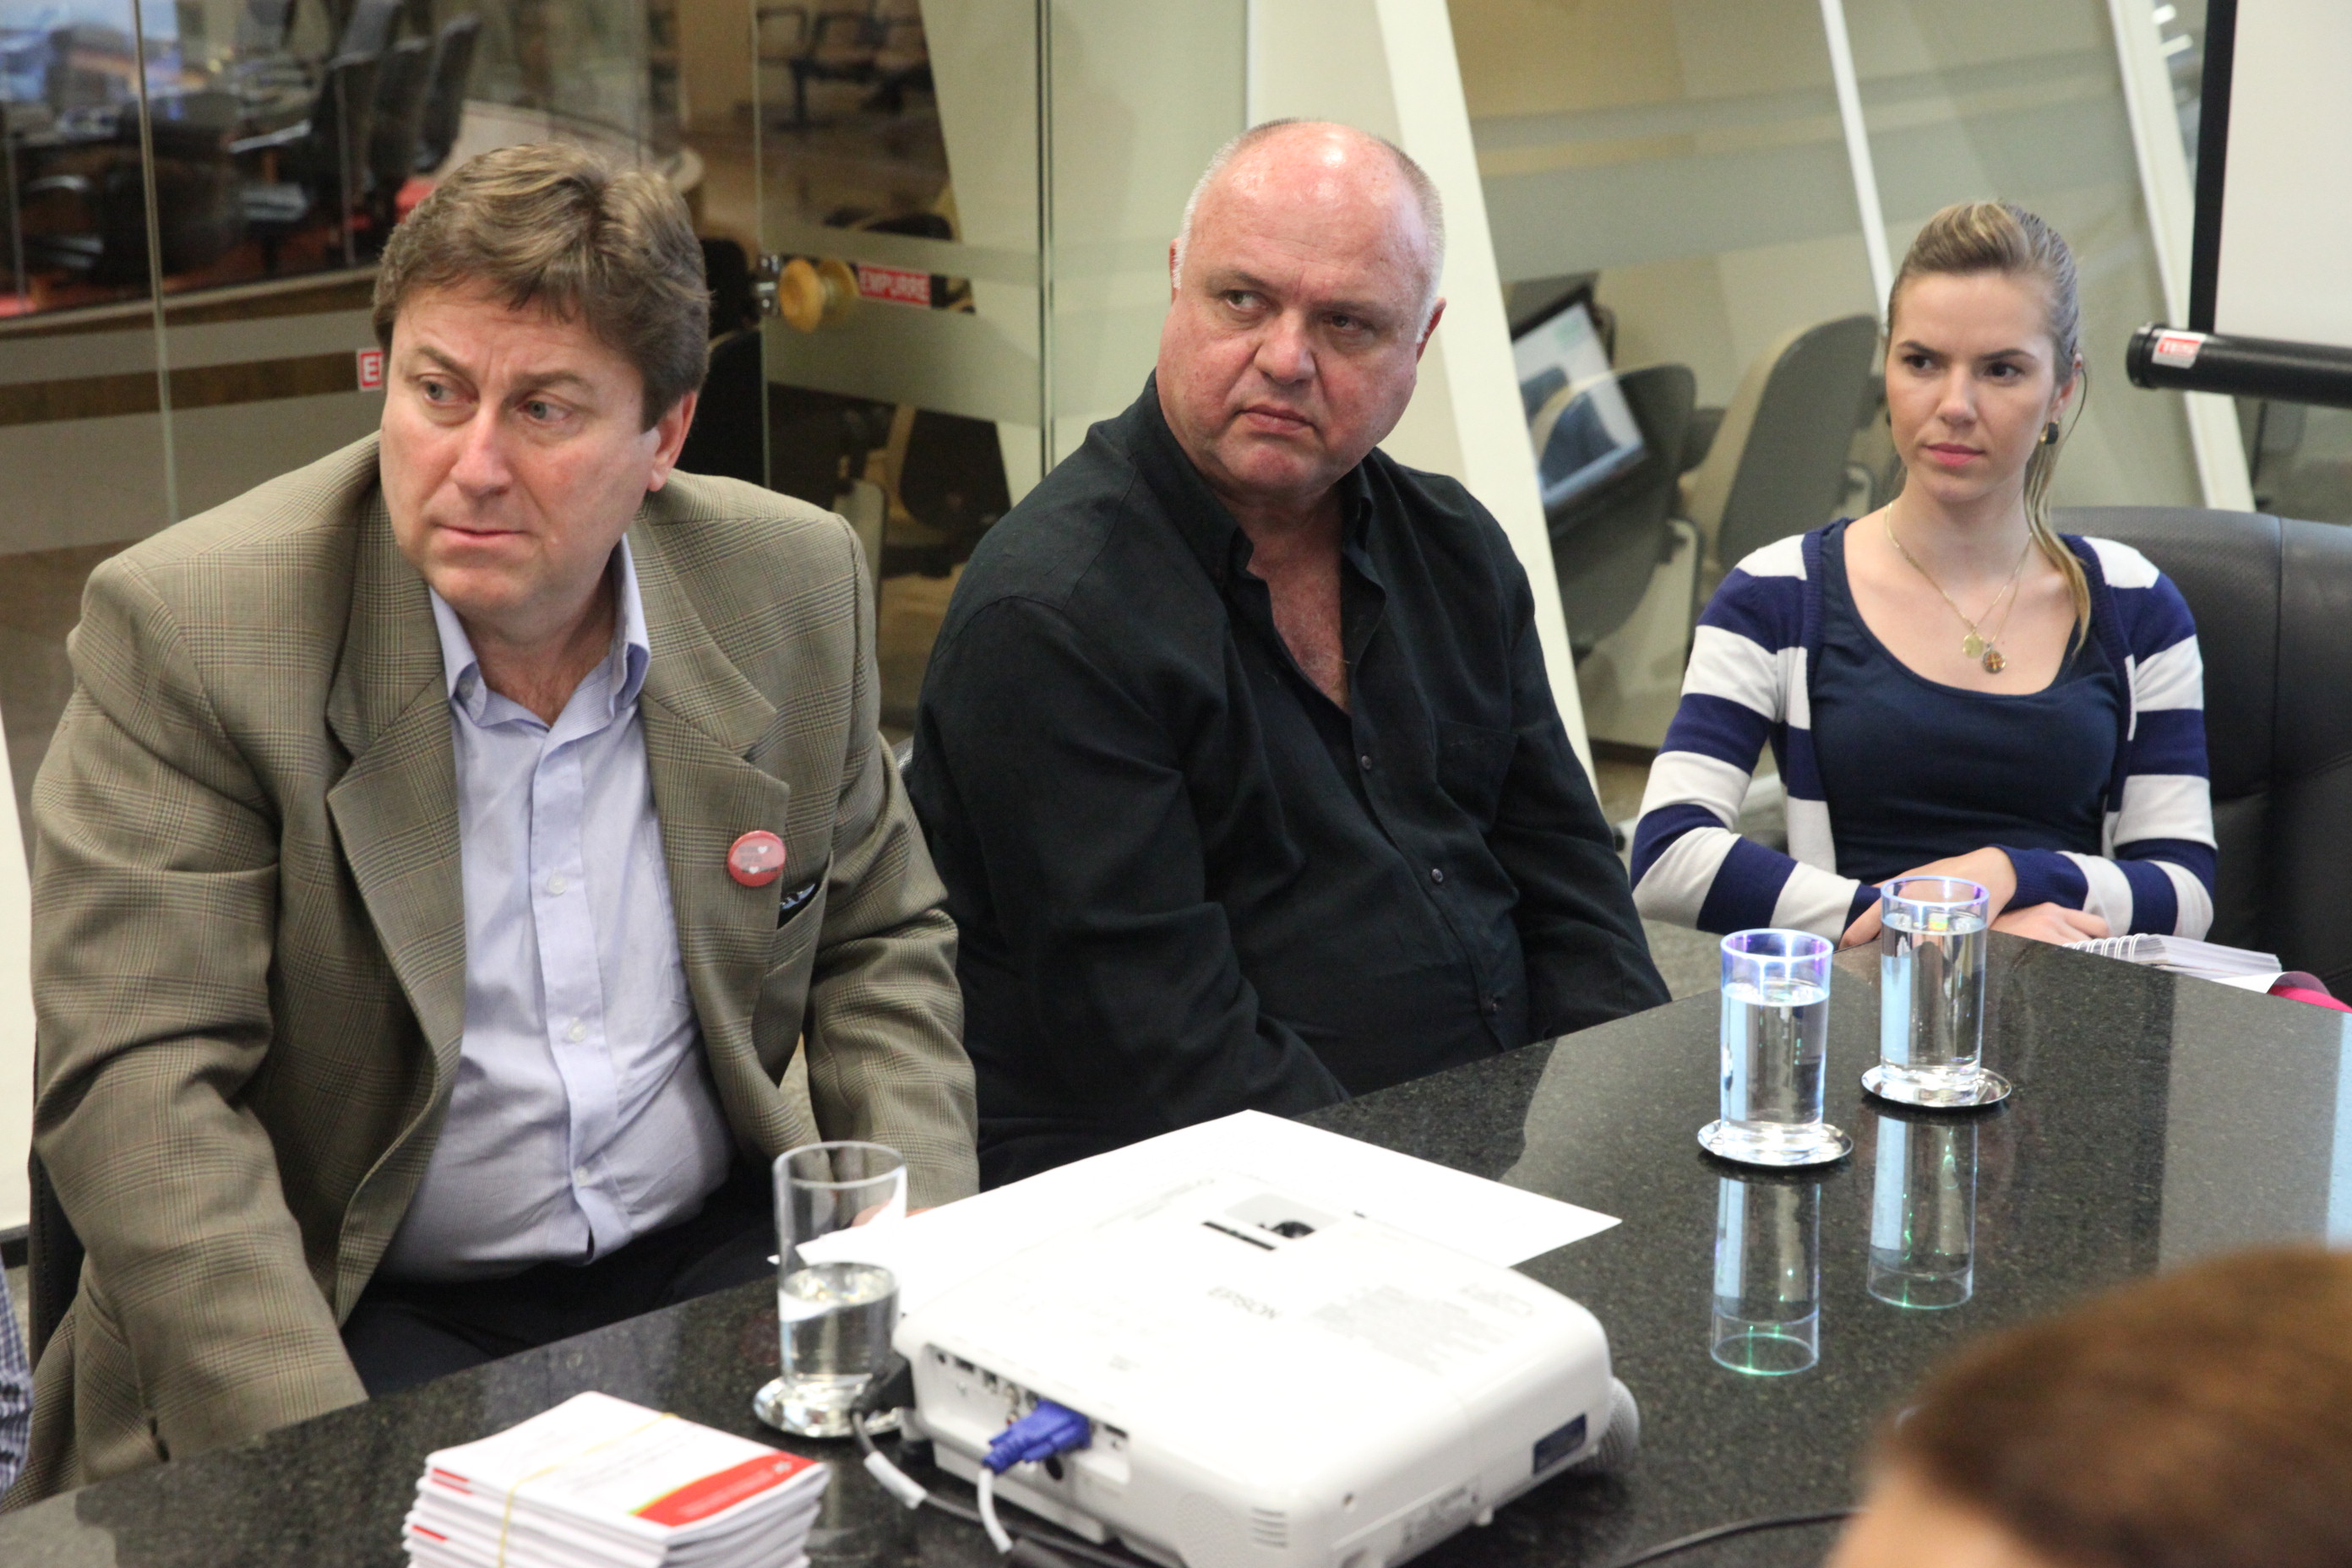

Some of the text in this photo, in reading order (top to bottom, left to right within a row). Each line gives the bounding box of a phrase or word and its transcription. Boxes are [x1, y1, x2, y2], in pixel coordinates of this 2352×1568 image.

[859, 269, 929, 301] EMPURRE
[364, 356, 382, 382] E
[1206, 1286, 1283, 1320] EPSON
